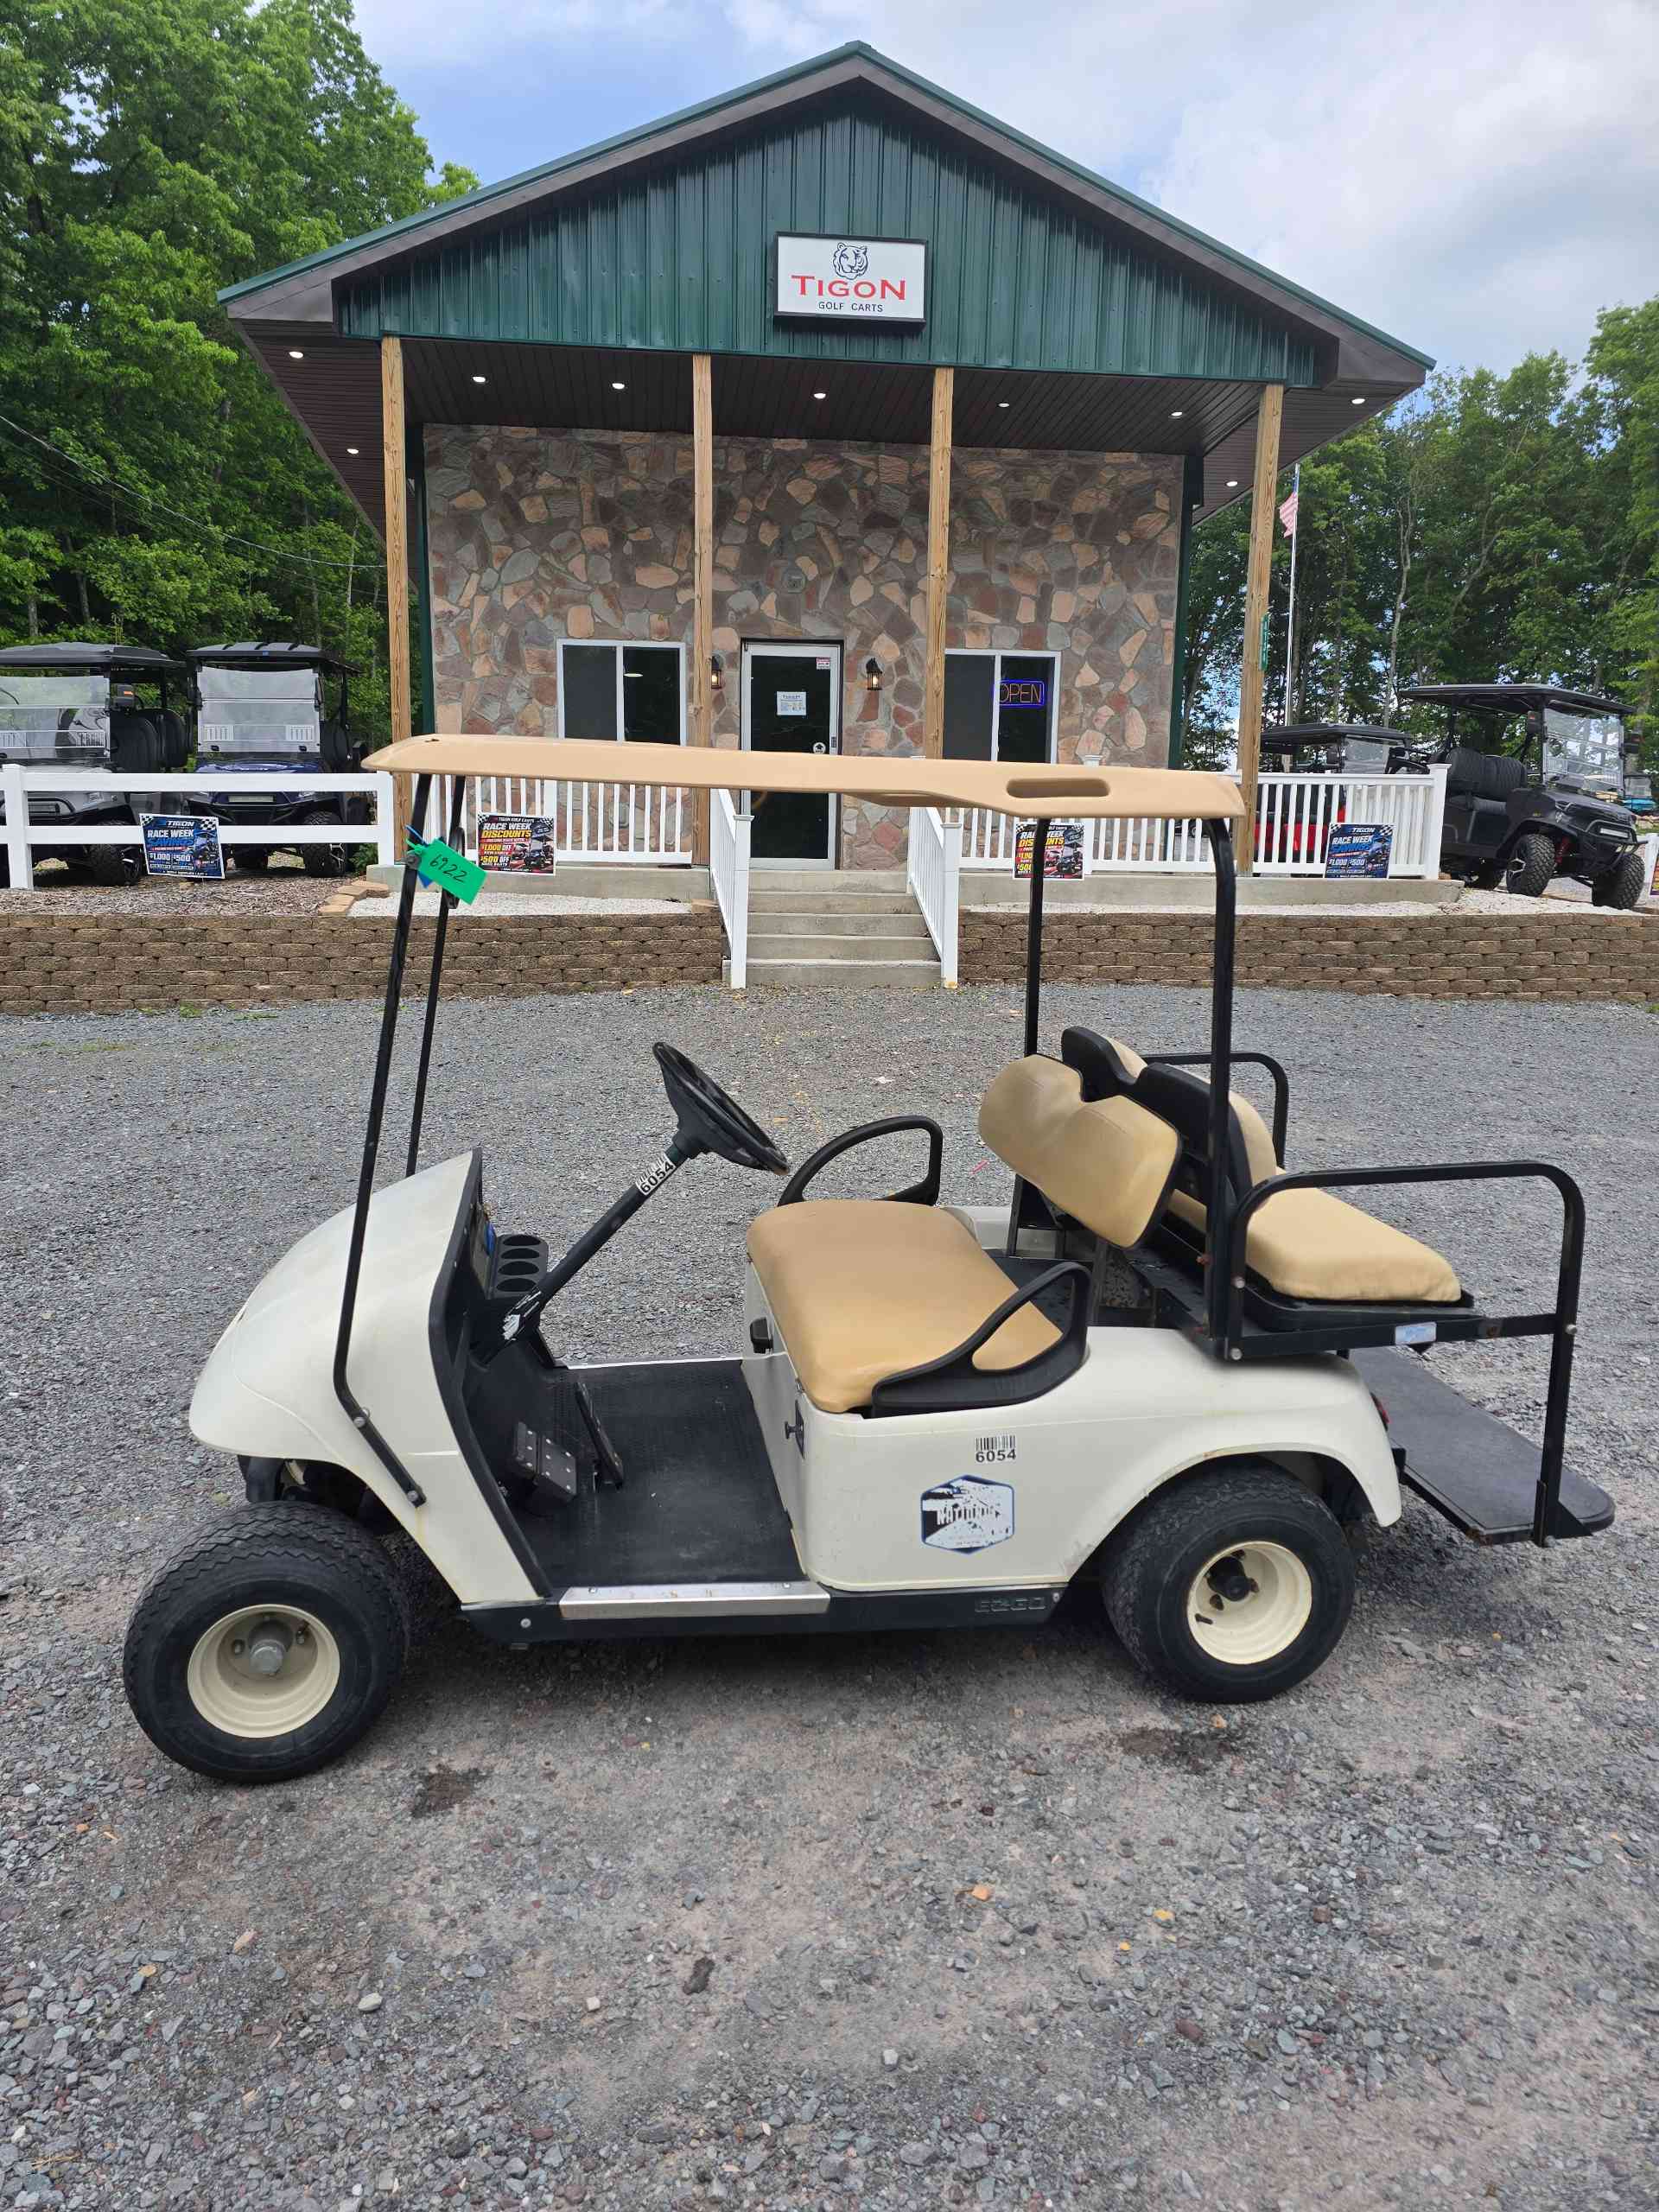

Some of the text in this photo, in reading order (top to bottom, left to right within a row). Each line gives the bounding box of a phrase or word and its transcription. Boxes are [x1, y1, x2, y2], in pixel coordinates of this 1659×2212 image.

[791, 275, 906, 300] TIGON
[818, 301, 883, 312] GOLF CARTS
[999, 683, 1041, 702] OPEN
[147, 830, 194, 838] RACE WEEK
[482, 830, 531, 838] DISCOUNTS
[1332, 836, 1373, 845] RACE WEEK
[640, 1161, 674, 1193] 6054
[975, 1448, 1017, 1463] 6054
